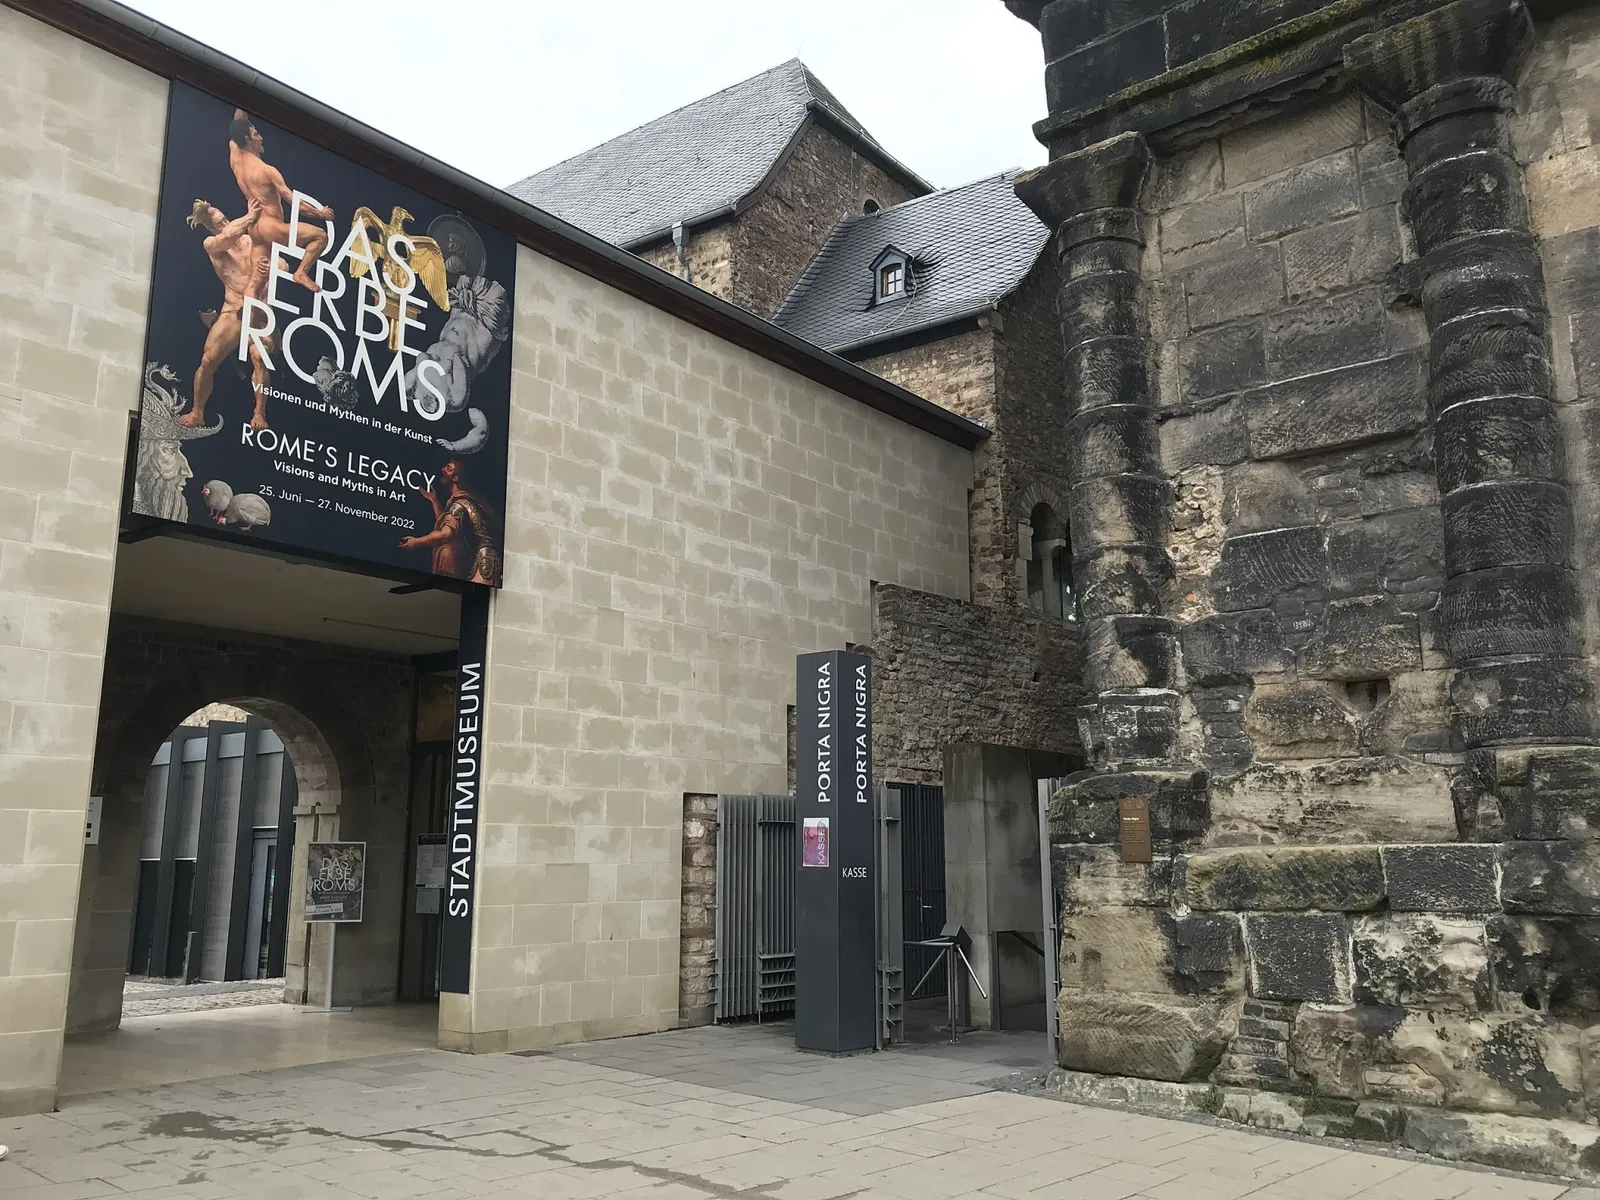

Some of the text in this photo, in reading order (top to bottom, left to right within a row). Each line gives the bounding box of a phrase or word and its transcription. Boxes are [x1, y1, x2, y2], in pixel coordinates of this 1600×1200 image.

[287, 189, 416, 295] DAS
[267, 241, 428, 357] ERBE
[238, 295, 446, 421] ROMS
[251, 381, 433, 444] Visionen und Mythen in der Kunst
[273, 459, 406, 503] Visions and Myths in Art
[347, 451, 436, 493] LEGACY
[258, 484, 275, 497] 25.
[278, 488, 302, 503] Juni
[317, 498, 332, 511] 27.
[335, 502, 388, 523] November
[390, 516, 415, 530] 2022
[817, 661, 831, 803] PORTA NIGRA
[855, 664, 867, 803] PORTA NIGRA
[448, 662, 481, 918] STADTMUSEUM
[322, 857, 349, 870] DAS
[817, 828, 826, 864] KASSE
[842, 867, 867, 878] KASSE
[313, 879, 356, 891] ROMS
